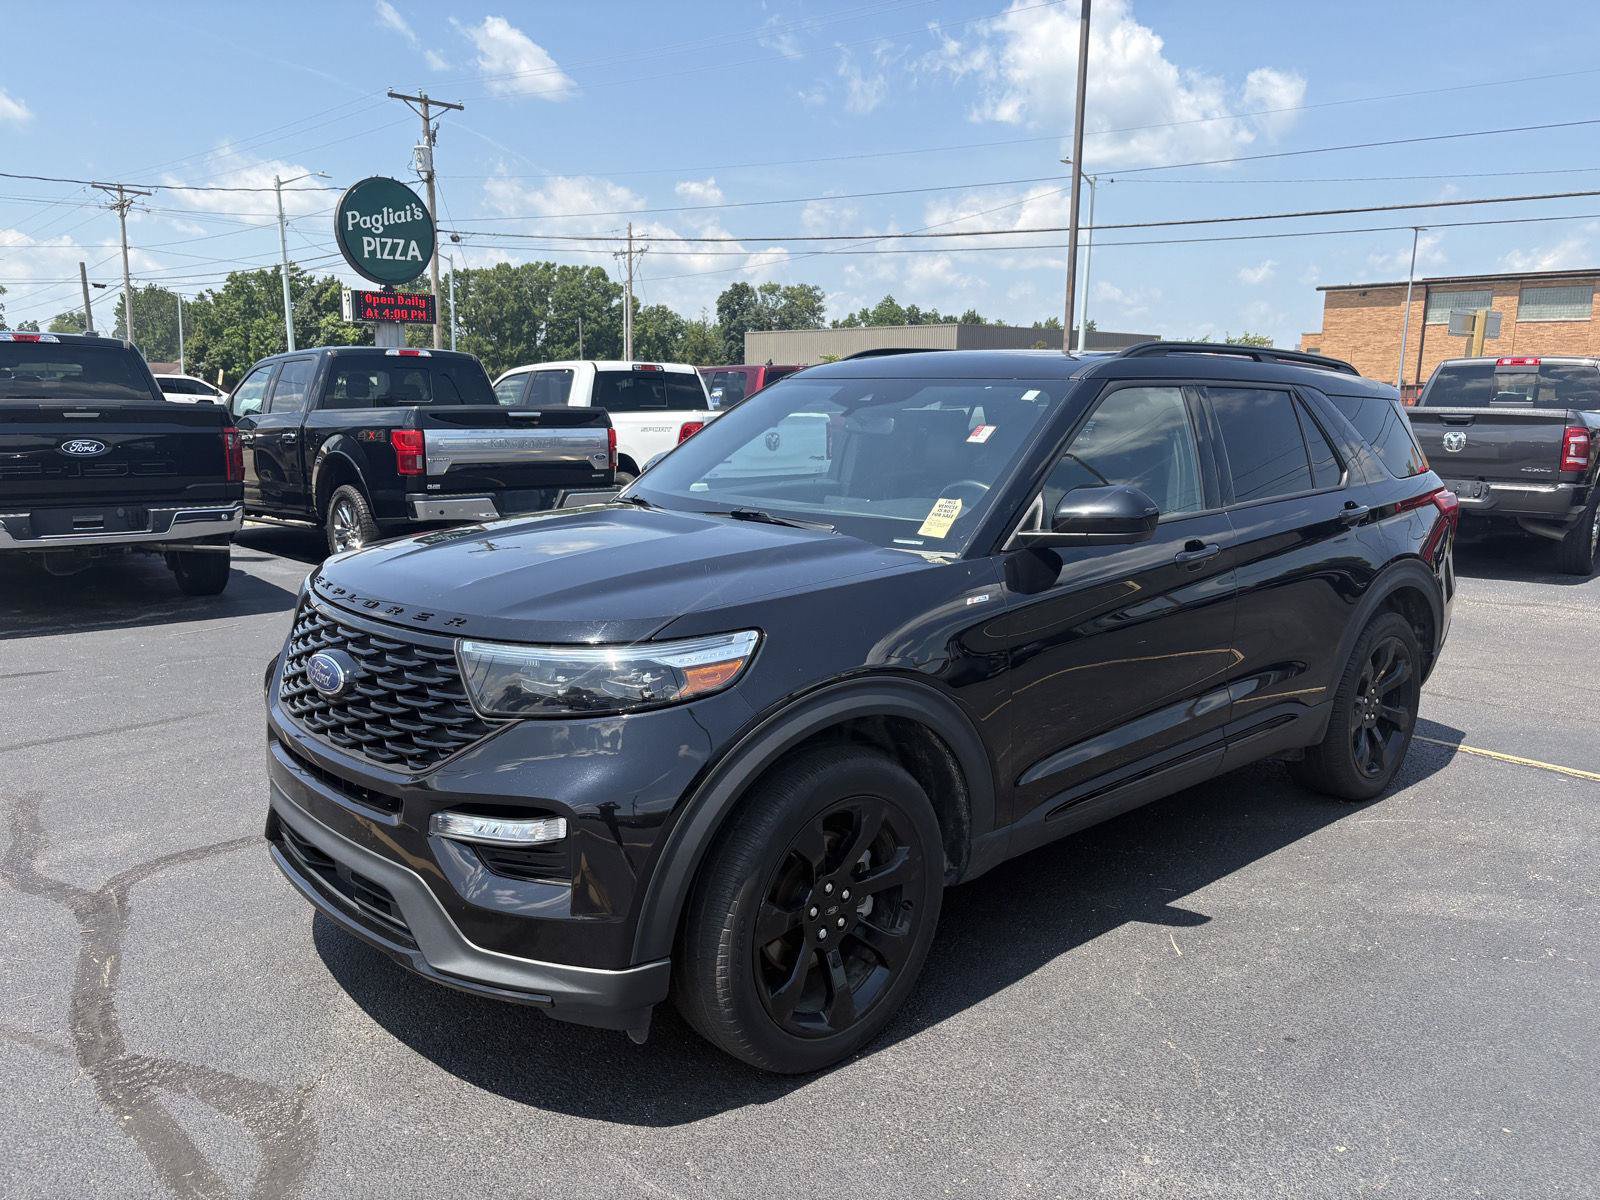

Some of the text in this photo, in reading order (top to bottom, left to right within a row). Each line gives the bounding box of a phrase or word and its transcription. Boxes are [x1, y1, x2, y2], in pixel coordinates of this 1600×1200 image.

[346, 203, 424, 234] Pagliai's
[362, 236, 423, 262] PIZZA
[365, 293, 427, 307] Open Daily
[366, 308, 427, 320] At 4:00 PM
[314, 575, 468, 628] EXPLORER
